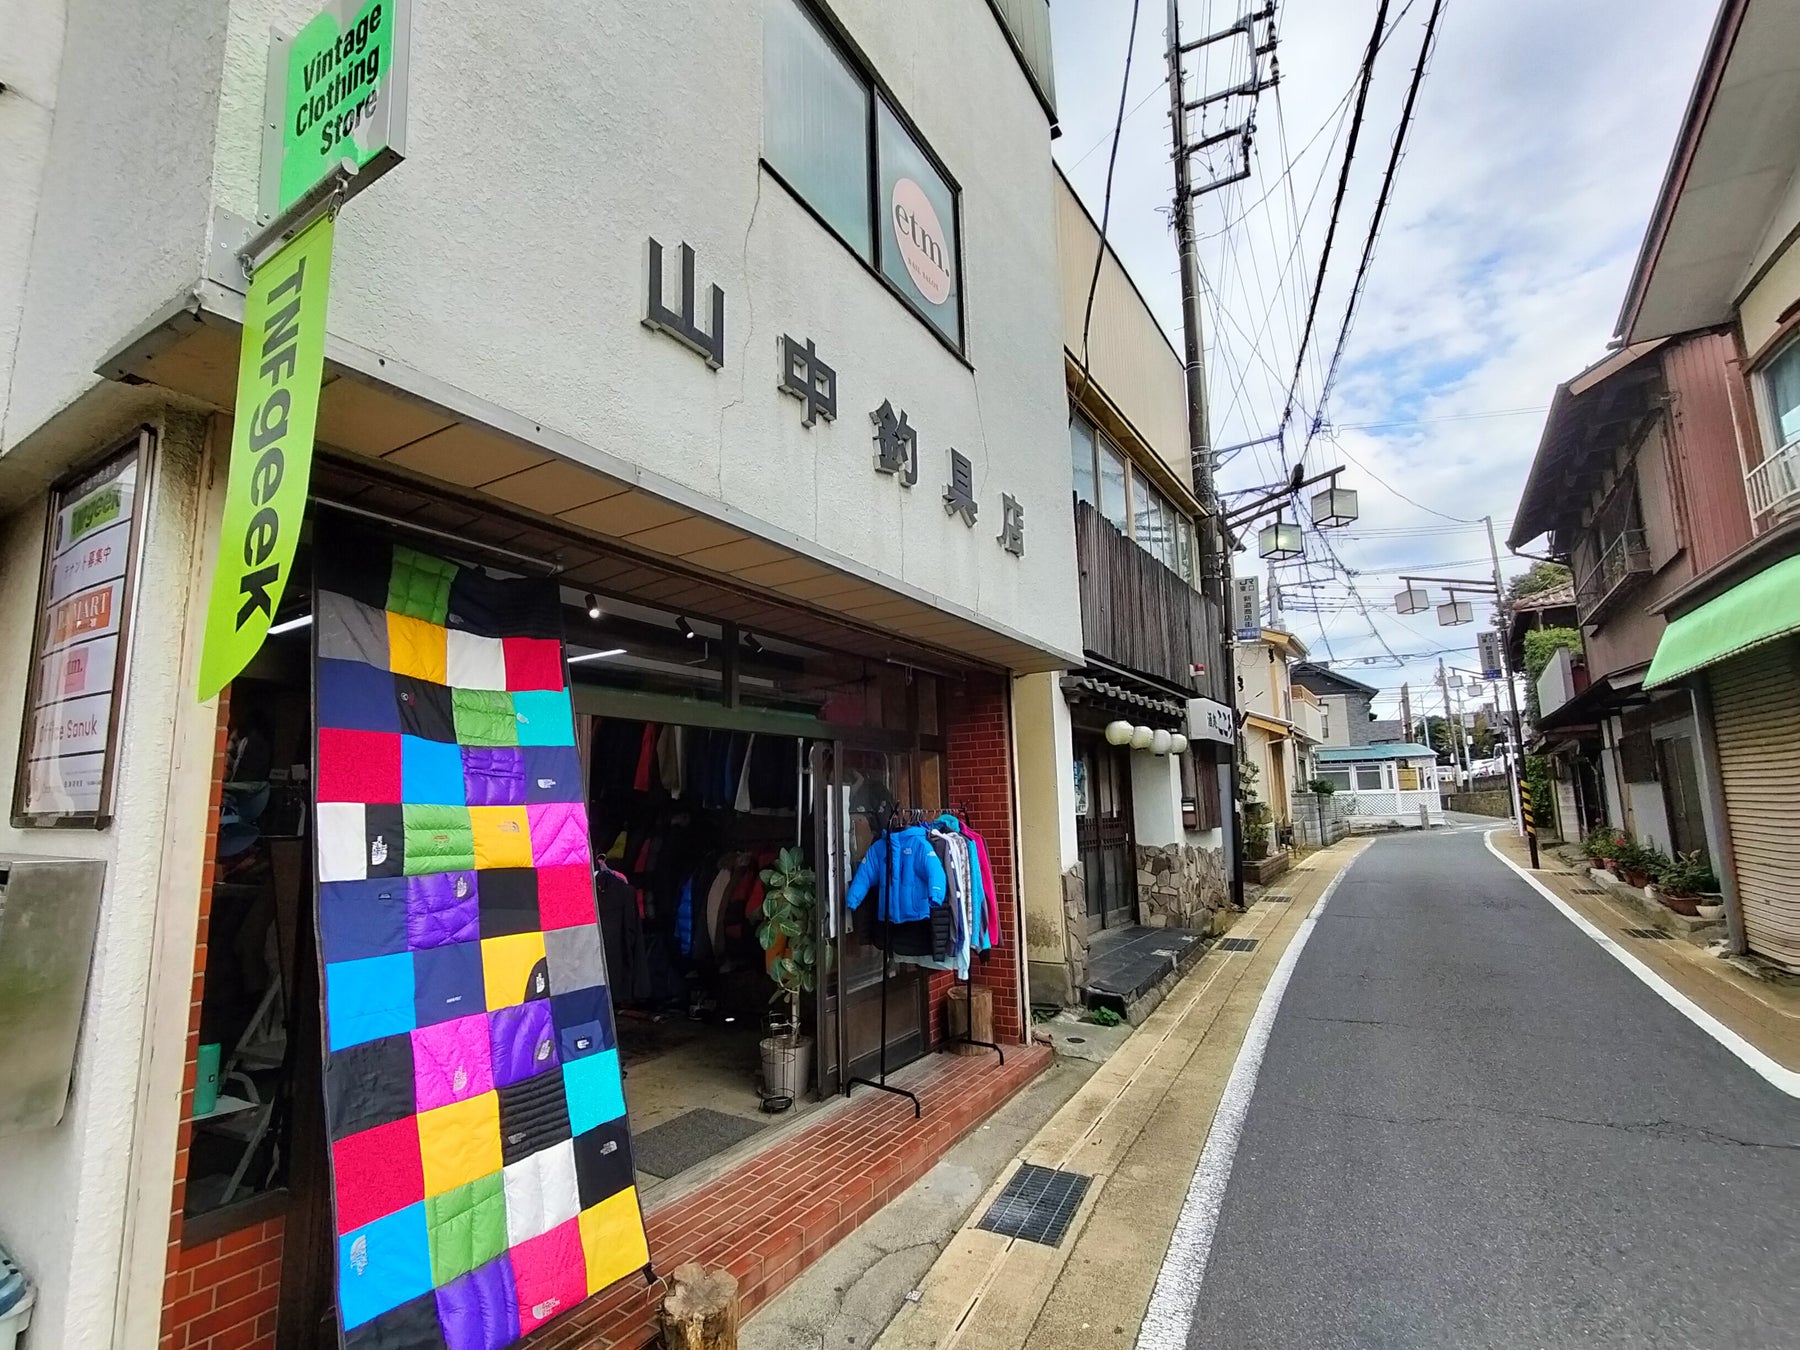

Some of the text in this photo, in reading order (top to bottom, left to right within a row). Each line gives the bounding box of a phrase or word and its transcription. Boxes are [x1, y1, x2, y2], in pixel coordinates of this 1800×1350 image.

[296, 44, 380, 137] Clothing
[303, 4, 382, 93] Vintage
[320, 89, 378, 155] Store
[235, 254, 307, 633] TNFgeek
[641, 236, 1025, 558] 山中釣具店
